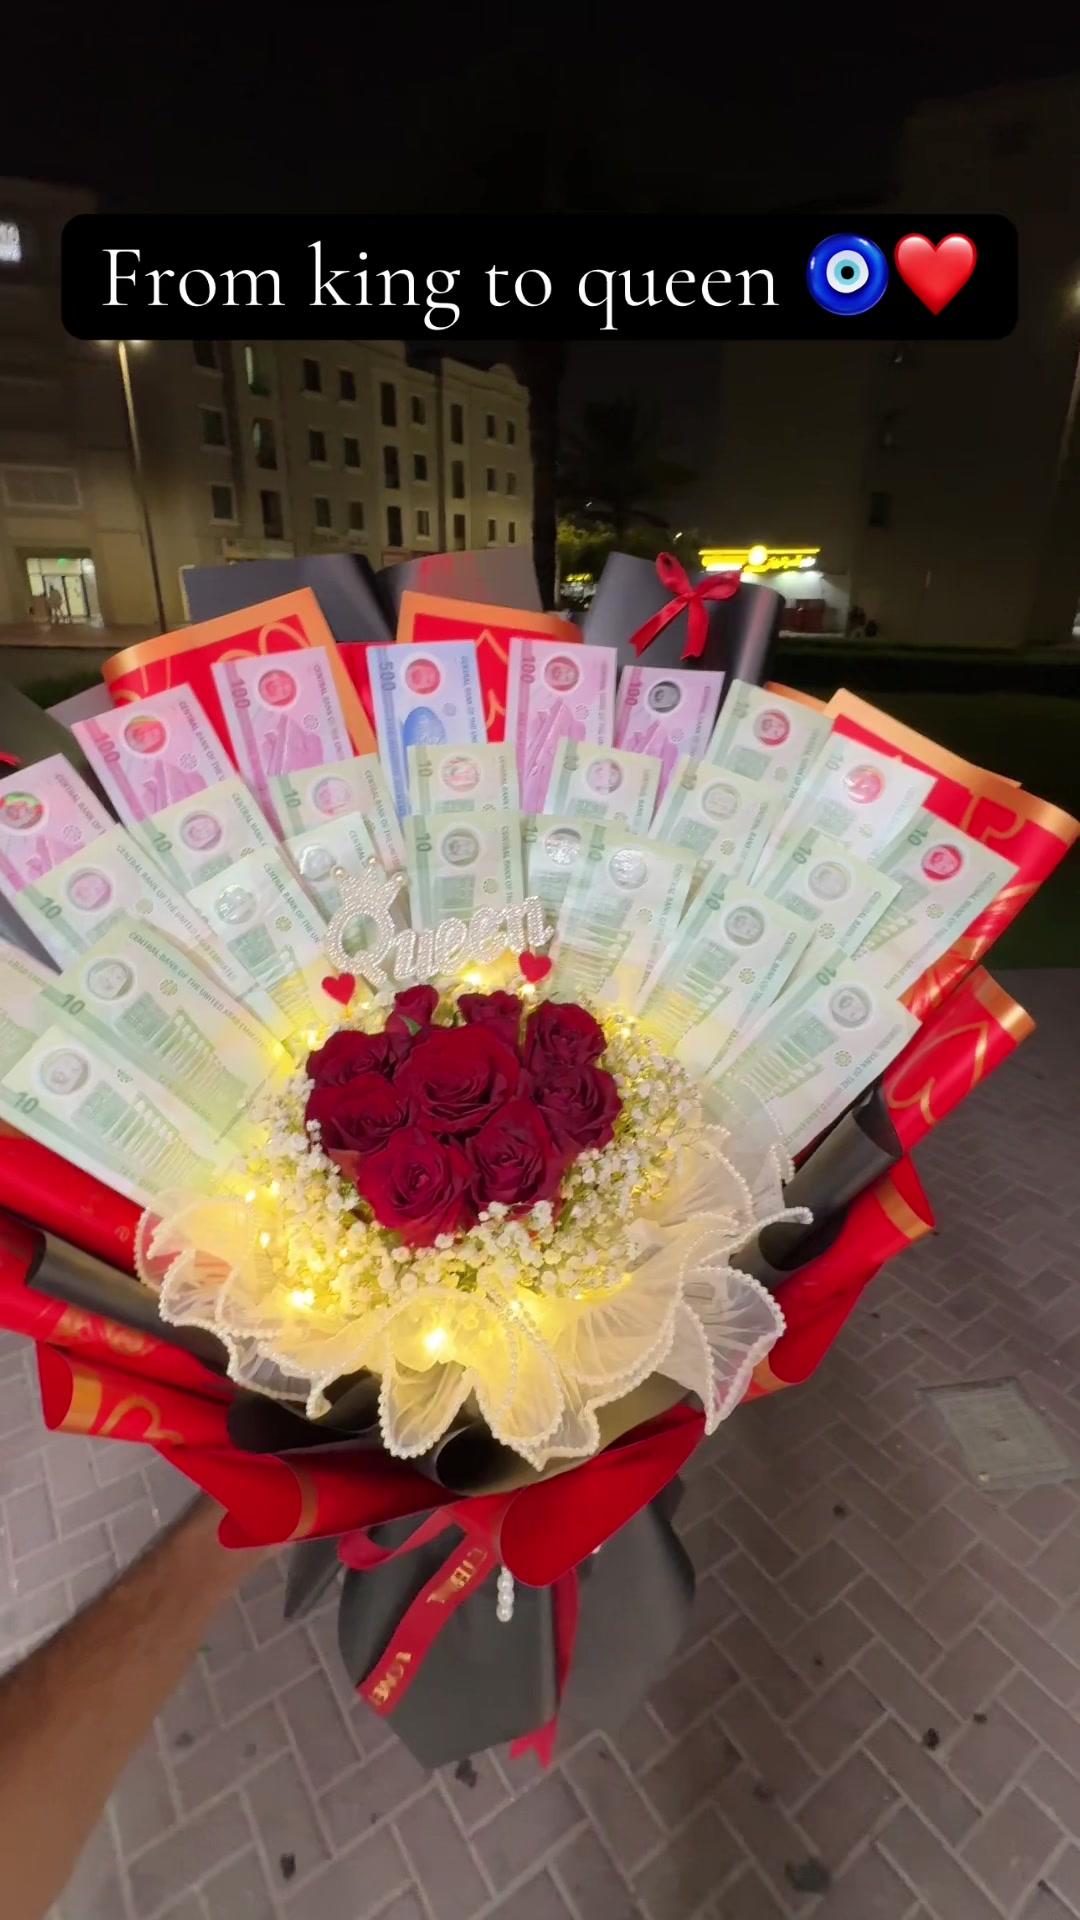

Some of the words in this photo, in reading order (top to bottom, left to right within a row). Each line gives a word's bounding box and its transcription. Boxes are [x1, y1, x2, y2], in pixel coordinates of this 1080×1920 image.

[311, 663, 329, 696] CENTRAL
[379, 661, 397, 692] 500
[521, 655, 536, 685] 100
[229, 678, 250, 709] 100
[624, 680, 642, 707] 100
[176, 699, 200, 732] CENTRAL
[94, 733, 121, 763] 100
[418, 760, 433, 778] 10
[825, 754, 844, 772] 10
[362, 768, 381, 800] CENTRAL
[278, 789, 302, 809] 10
[229, 791, 255, 824] CENTRAL
[248, 820, 267, 844] BANK
[152, 831, 173, 852] 10
[416, 832, 432, 852] 10
[908, 827, 929, 847] 10
[589, 843, 603, 862] 10
[792, 846, 813, 865] 10
[114, 843, 143, 874] CENTRAL
[138, 870, 159, 892] BANK
[38, 896, 61, 920] 10
[261, 861, 287, 894] CENTRAL
[281, 890, 300, 912] BANK
[300, 917, 315, 934] THE
[705, 892, 726, 911] 10
[325, 893, 554, 988] Queen
[126, 928, 161, 960] CENTRAL
[185, 976, 202, 992] THE
[197, 986, 225, 1012] UNITED
[816, 967, 838, 986] 10
[62, 993, 86, 1015] 10
[14, 1091, 39, 1114] 10
